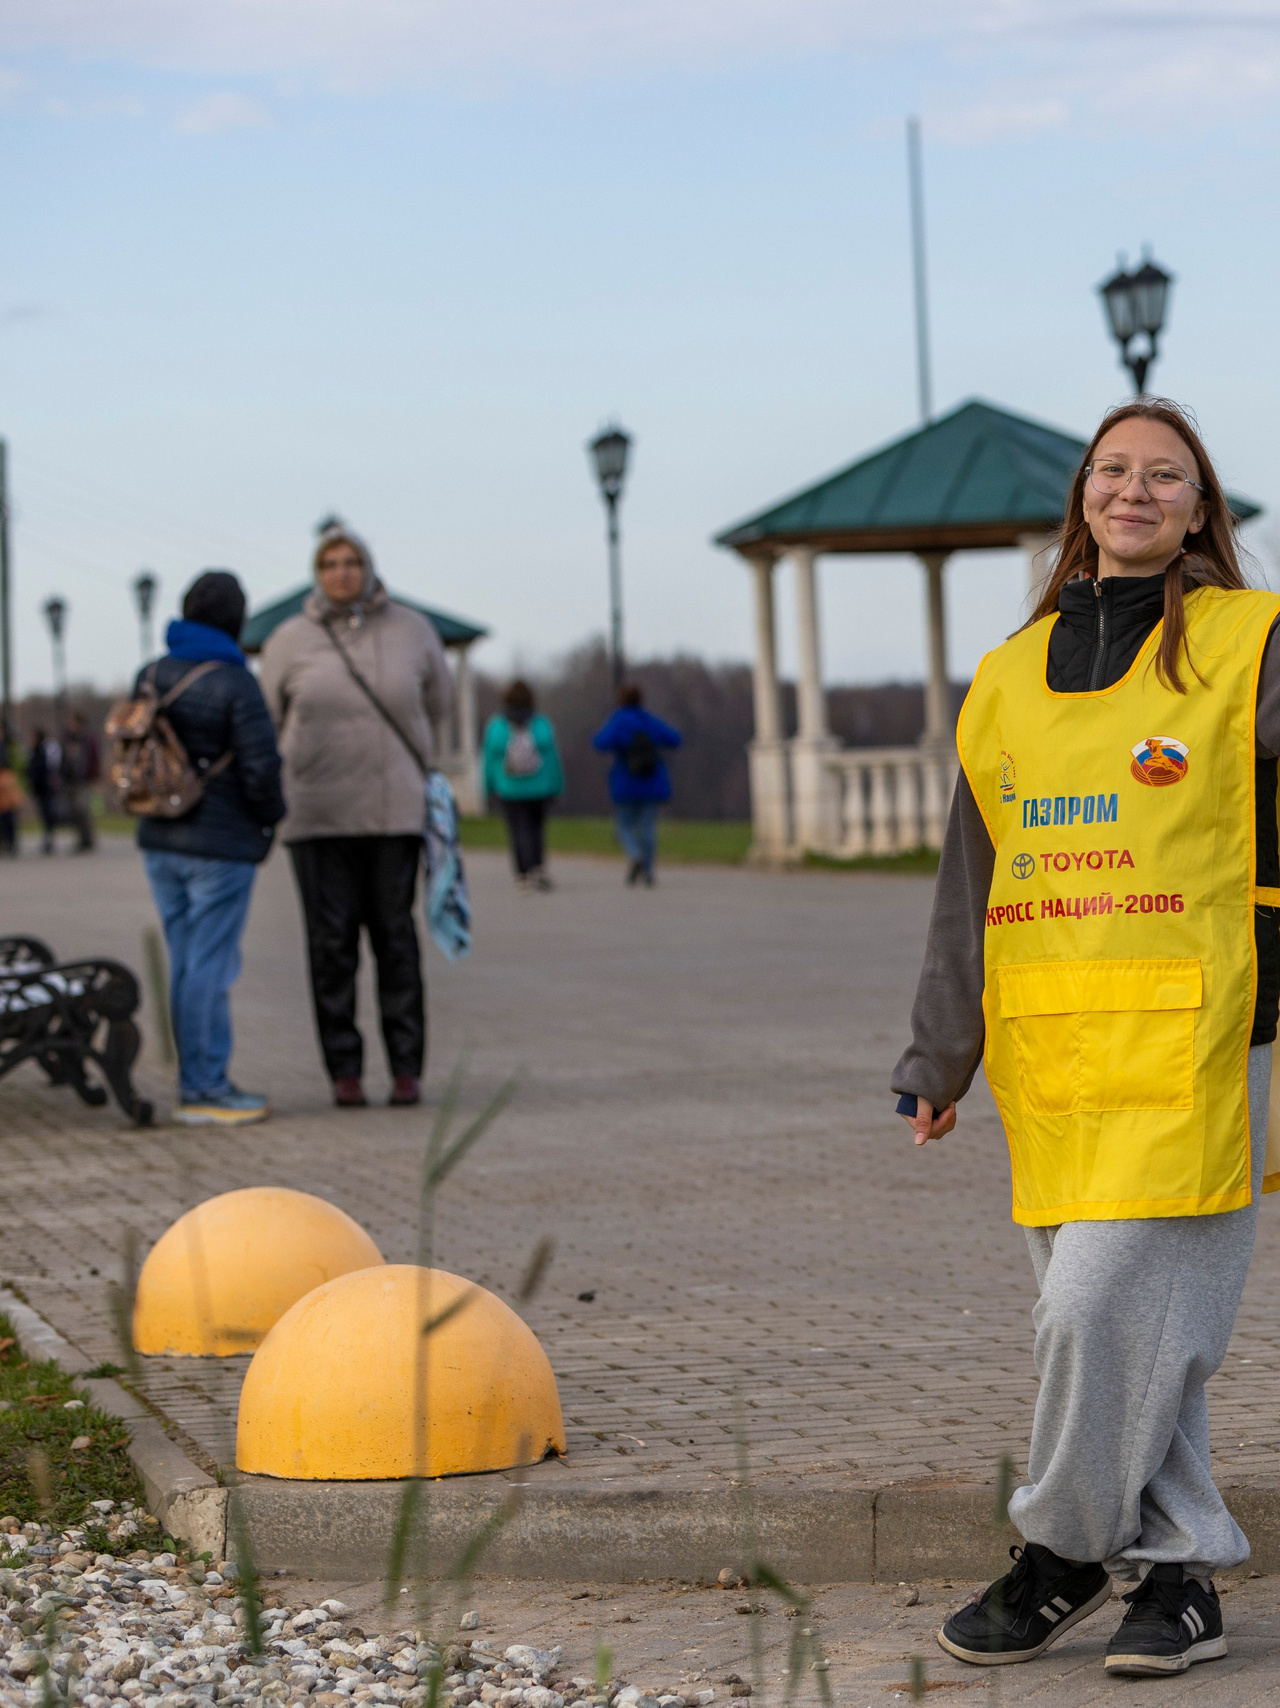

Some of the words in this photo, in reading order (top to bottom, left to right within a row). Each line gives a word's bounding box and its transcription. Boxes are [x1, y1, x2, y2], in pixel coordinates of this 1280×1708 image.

[1022, 793, 1119, 829] ГАЗПРОМ
[1040, 849, 1135, 872] TOYOTA
[986, 901, 1034, 927] КРОСС
[1040, 892, 1185, 920] НАЦИЙ-2006
